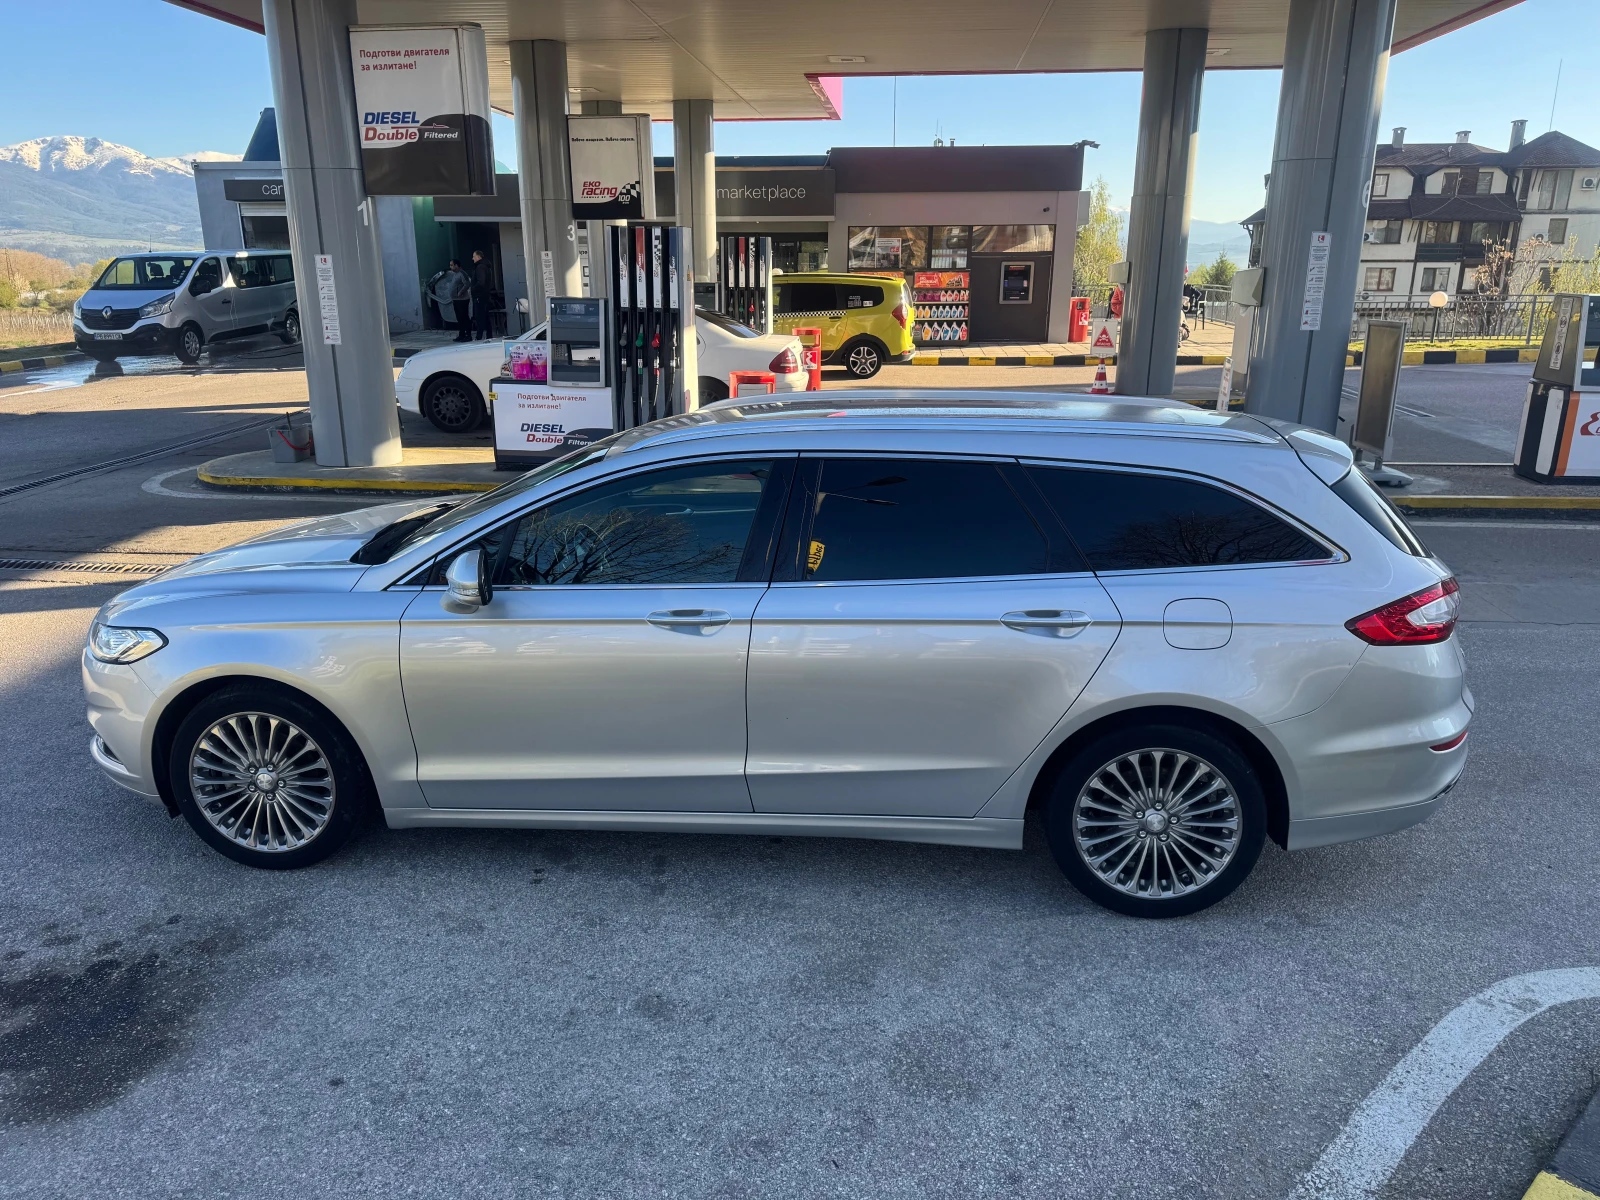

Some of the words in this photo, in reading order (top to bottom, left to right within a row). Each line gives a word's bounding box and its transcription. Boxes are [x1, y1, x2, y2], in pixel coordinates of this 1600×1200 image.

[359, 49, 402, 59] Подготви
[403, 48, 450, 58] двигателя
[372, 60, 417, 71] излитане!
[363, 111, 420, 125] DIESEL
[364, 127, 418, 141] Double
[423, 131, 459, 139] Filtered
[261, 184, 283, 195] car
[582, 187, 618, 198] racing
[618, 194, 631, 202] 100
[357, 200, 368, 226] 1
[566, 224, 575, 242] 3
[517, 392, 550, 403] Подготви
[551, 393, 587, 402] двигателя
[520, 423, 566, 433] DIESEL
[526, 433, 563, 444] Double
